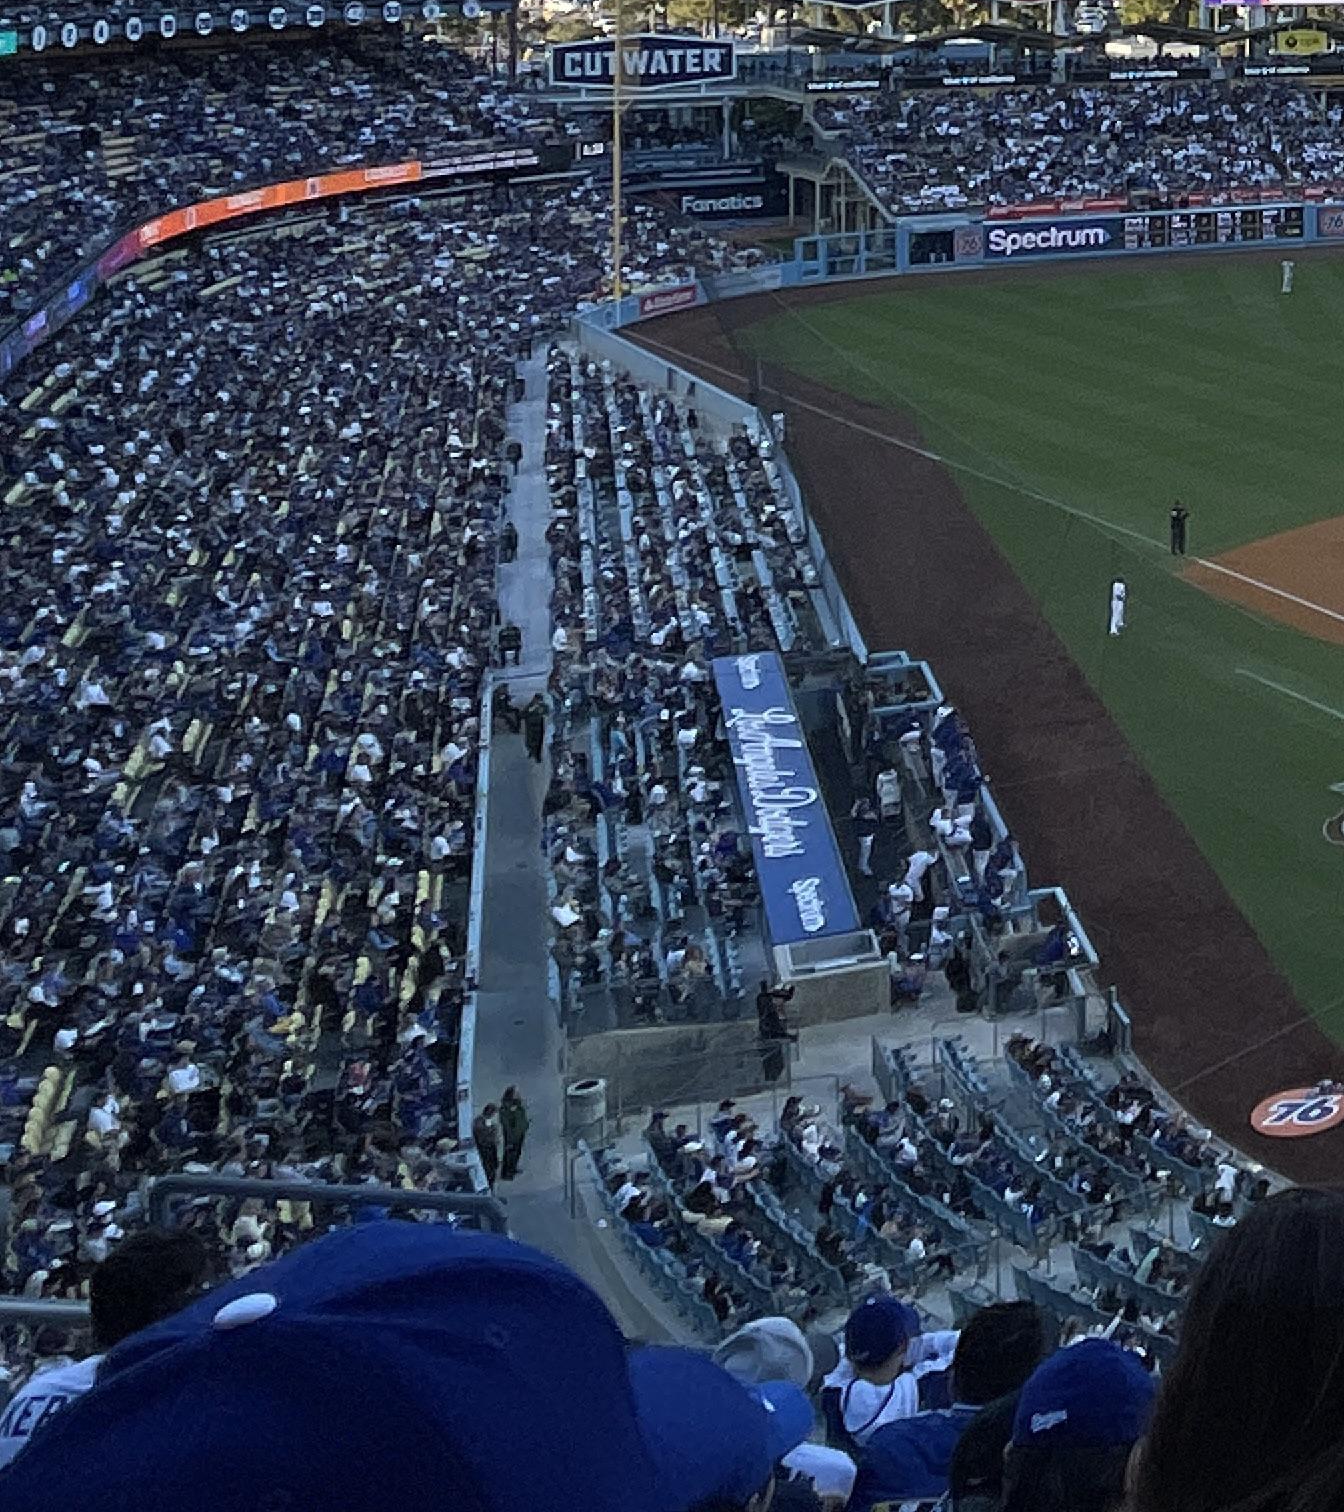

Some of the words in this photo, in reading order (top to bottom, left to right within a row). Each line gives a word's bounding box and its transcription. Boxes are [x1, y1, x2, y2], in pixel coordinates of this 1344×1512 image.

[564, 48, 723, 77] CUTWATER
[681, 194, 764, 214] Fanatics
[988, 226, 1106, 255] Spectrum
[1261, 1094, 1342, 1127] 76
